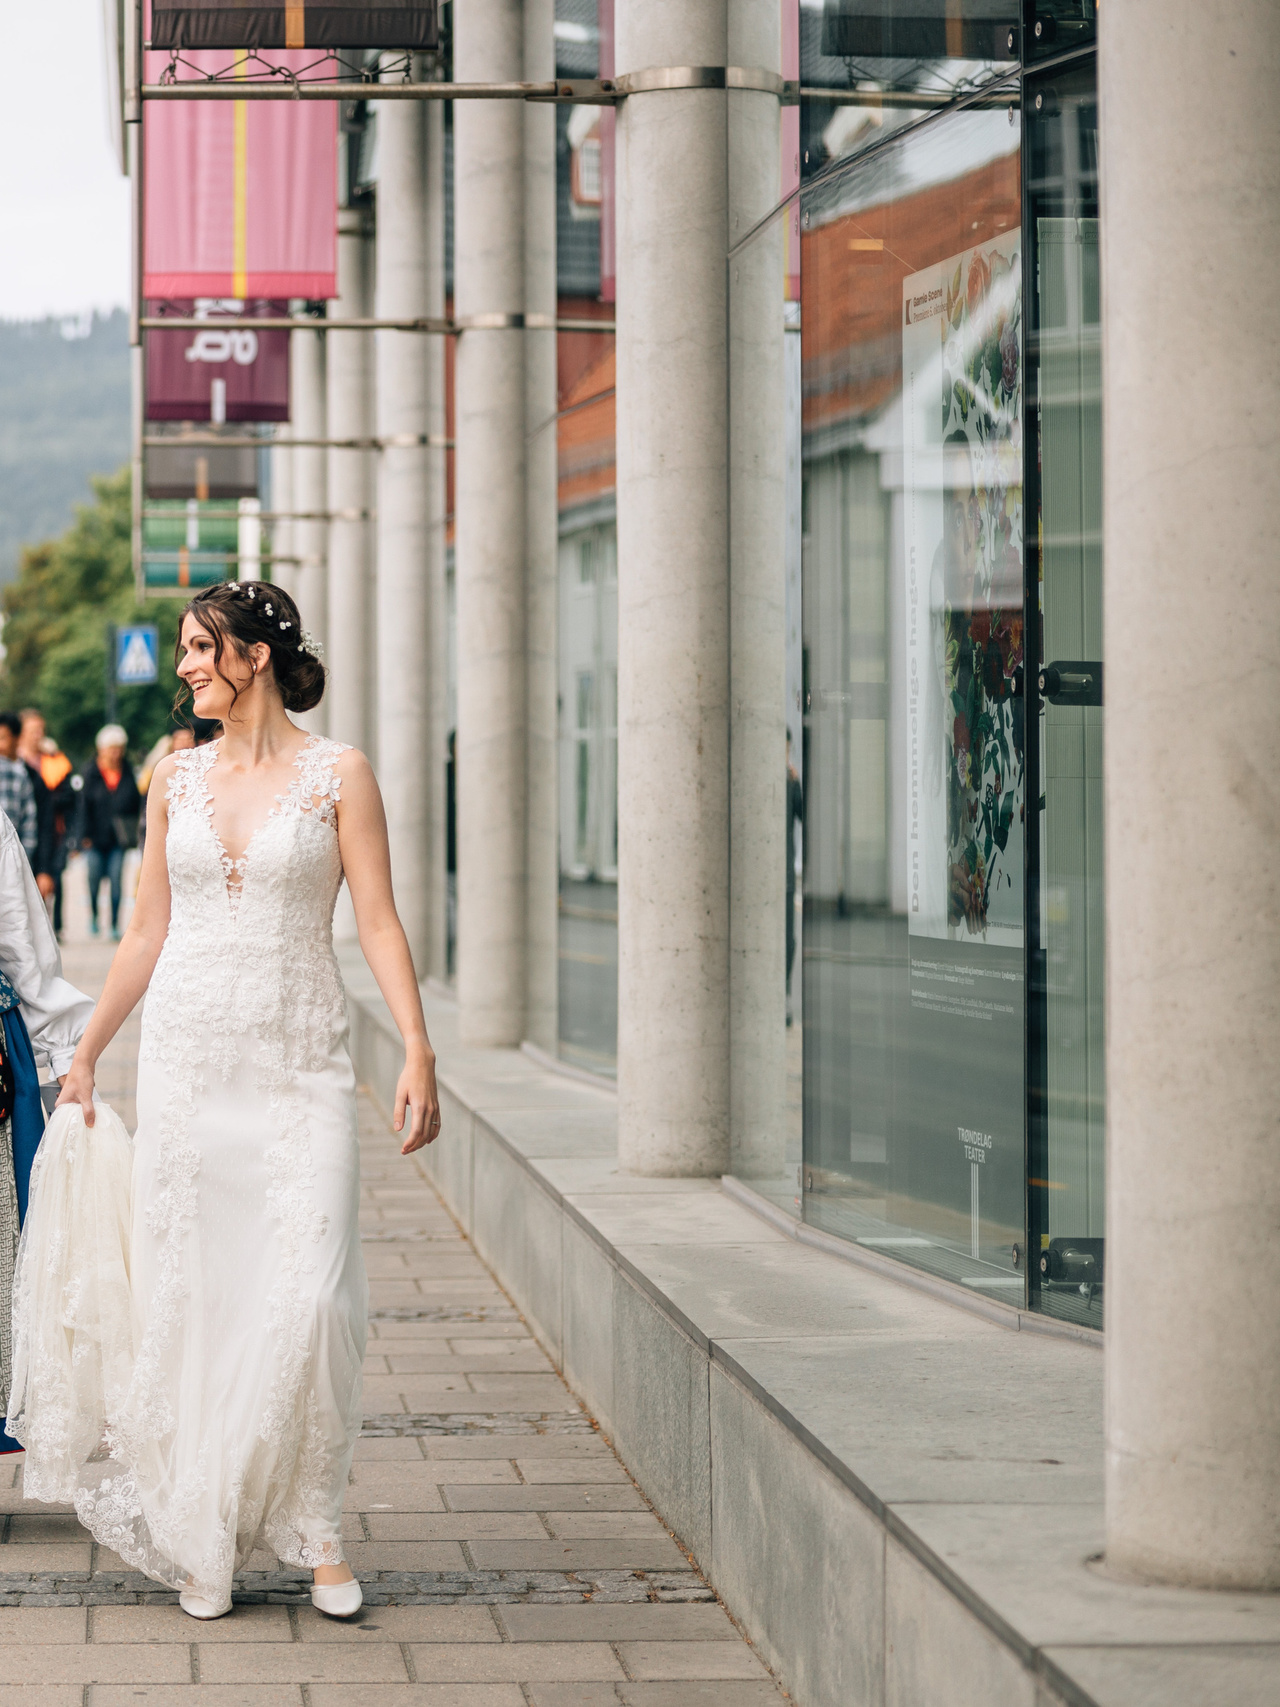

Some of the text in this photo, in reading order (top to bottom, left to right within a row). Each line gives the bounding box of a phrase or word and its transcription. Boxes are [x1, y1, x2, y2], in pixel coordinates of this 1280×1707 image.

[913, 288, 943, 308] Gamle Scene
[908, 545, 918, 647] hagen
[909, 656, 920, 840] hemmelige
[911, 850, 920, 914] Den
[957, 1127, 992, 1149] TRØNDELAG
[964, 1145, 986, 1164] TEATER
